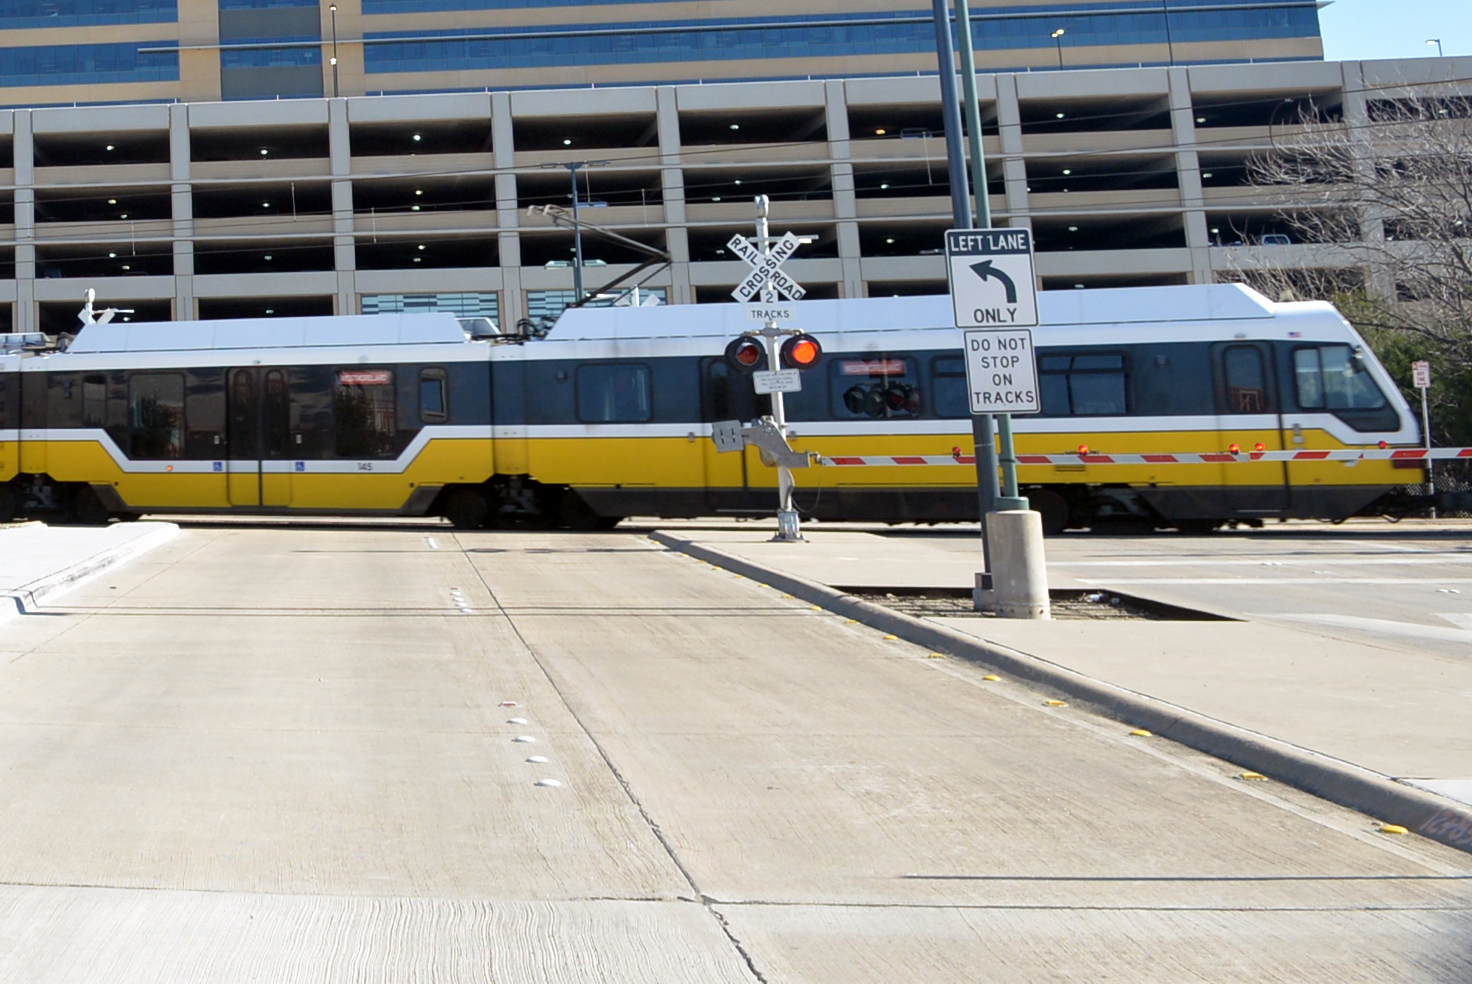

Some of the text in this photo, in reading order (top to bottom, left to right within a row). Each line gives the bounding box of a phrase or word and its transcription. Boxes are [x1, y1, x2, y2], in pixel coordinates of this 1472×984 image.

[950, 233, 1027, 251] LEFT LANE
[739, 239, 795, 298] CROSSING
[765, 292, 774, 304] 2
[751, 309, 790, 319] TRACKS
[973, 308, 1017, 323] ONLY
[971, 337, 1027, 351] DO NOT
[981, 356, 1020, 369] STOP
[992, 373, 1013, 386] ON
[974, 390, 1035, 405] TRACKS
